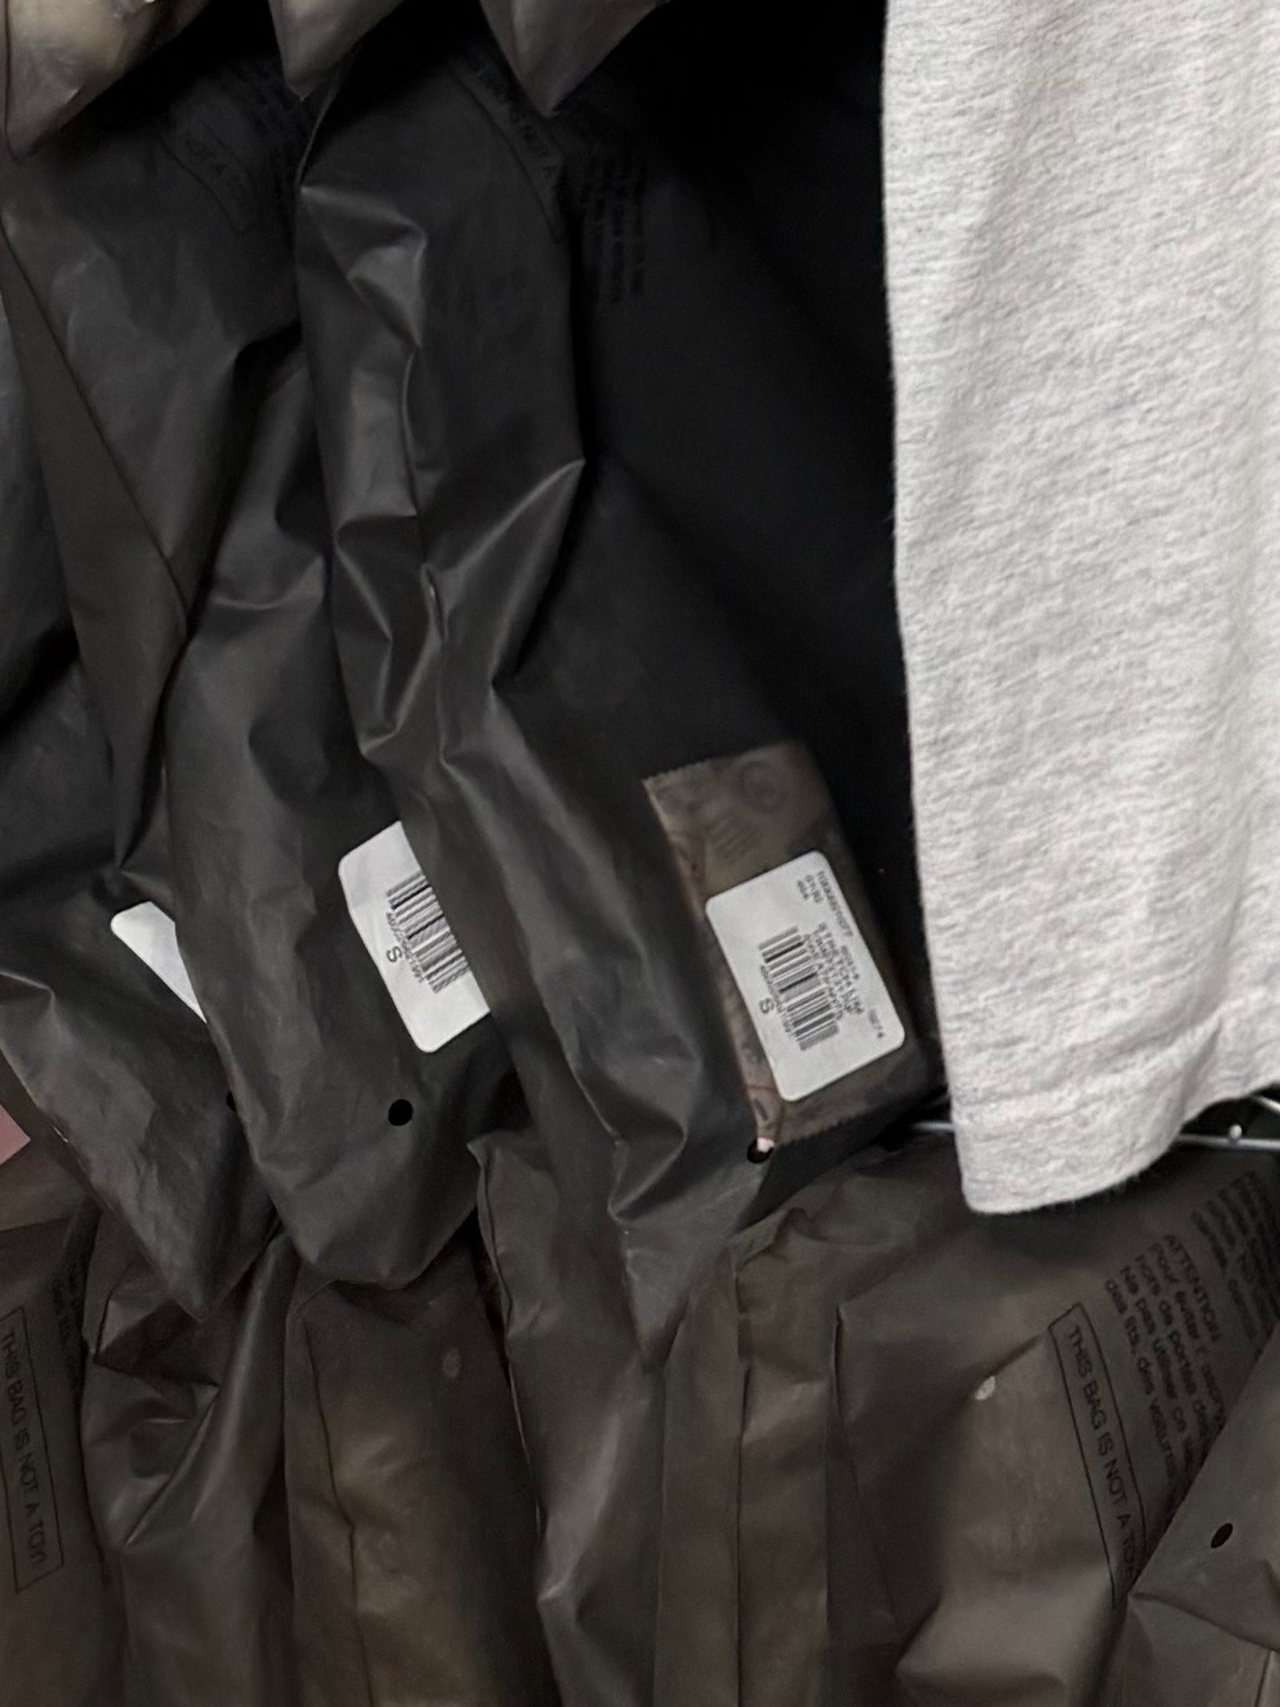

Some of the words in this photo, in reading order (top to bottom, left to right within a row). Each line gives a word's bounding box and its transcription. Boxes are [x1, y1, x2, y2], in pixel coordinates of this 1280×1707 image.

[386, 945, 404, 964] S
[1066, 1324, 1094, 1379] THIS
[1082, 1380, 1108, 1432] BAG
[1096, 1431, 1115, 1457] IS
[1103, 1458, 1130, 1507] NOT
